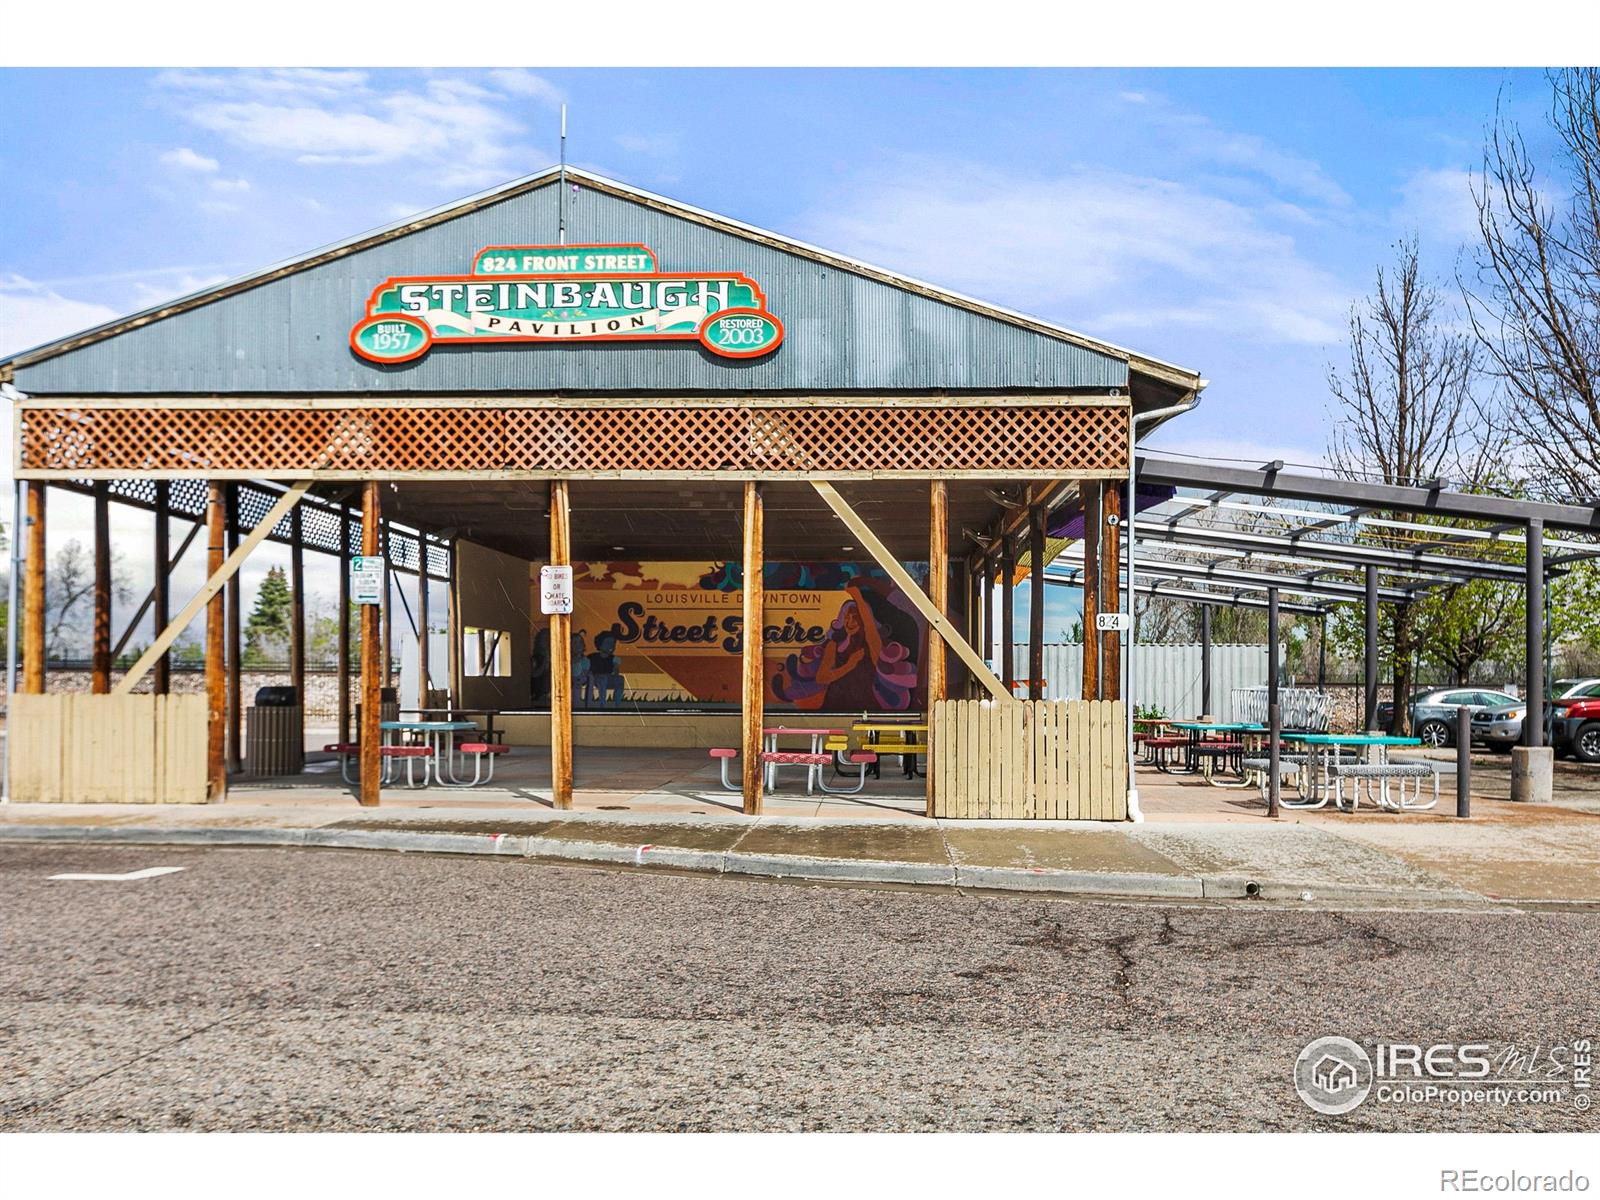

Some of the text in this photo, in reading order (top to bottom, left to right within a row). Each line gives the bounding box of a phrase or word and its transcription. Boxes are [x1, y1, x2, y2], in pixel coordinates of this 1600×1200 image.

[482, 254, 648, 272] 824 FRONT STREET
[400, 281, 730, 317] STEINBAUGH
[376, 323, 407, 334] BUILT
[488, 315, 645, 335] PAVILION
[719, 319, 764, 329] RESTORED
[373, 333, 411, 350] 1957
[719, 328, 764, 345] 2003
[354, 559, 363, 571] 2
[646, 593, 729, 605] LOUISVILLE
[736, 593, 821, 604] DNTOWN
[611, 601, 719, 644] Street
[1098, 615, 1119, 628] 824
